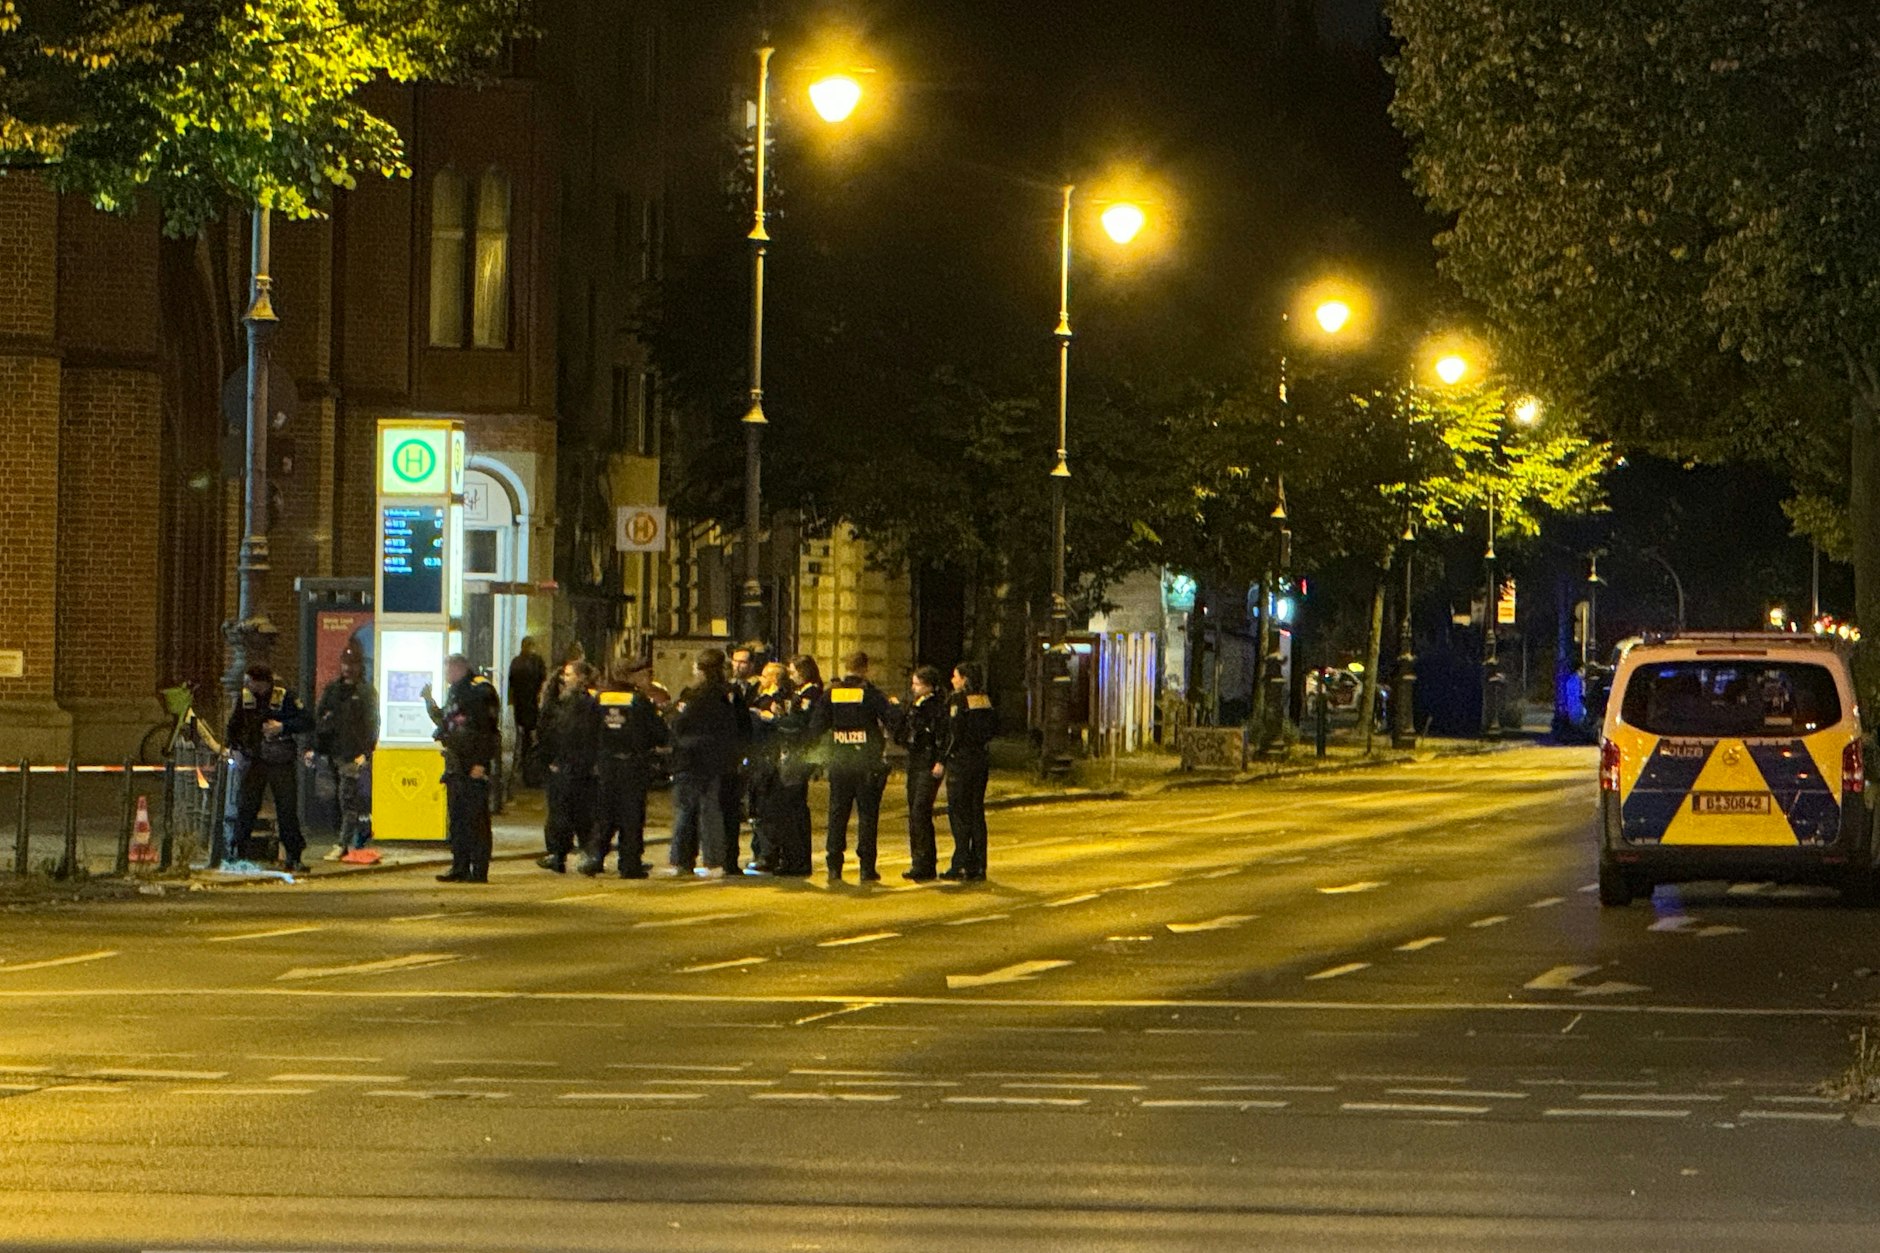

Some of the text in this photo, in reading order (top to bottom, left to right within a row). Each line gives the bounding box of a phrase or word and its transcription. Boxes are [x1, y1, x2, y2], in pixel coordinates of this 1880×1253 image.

[405, 449, 423, 473] H
[633, 519, 649, 539] H
[833, 730, 867, 744] POLIZEI
